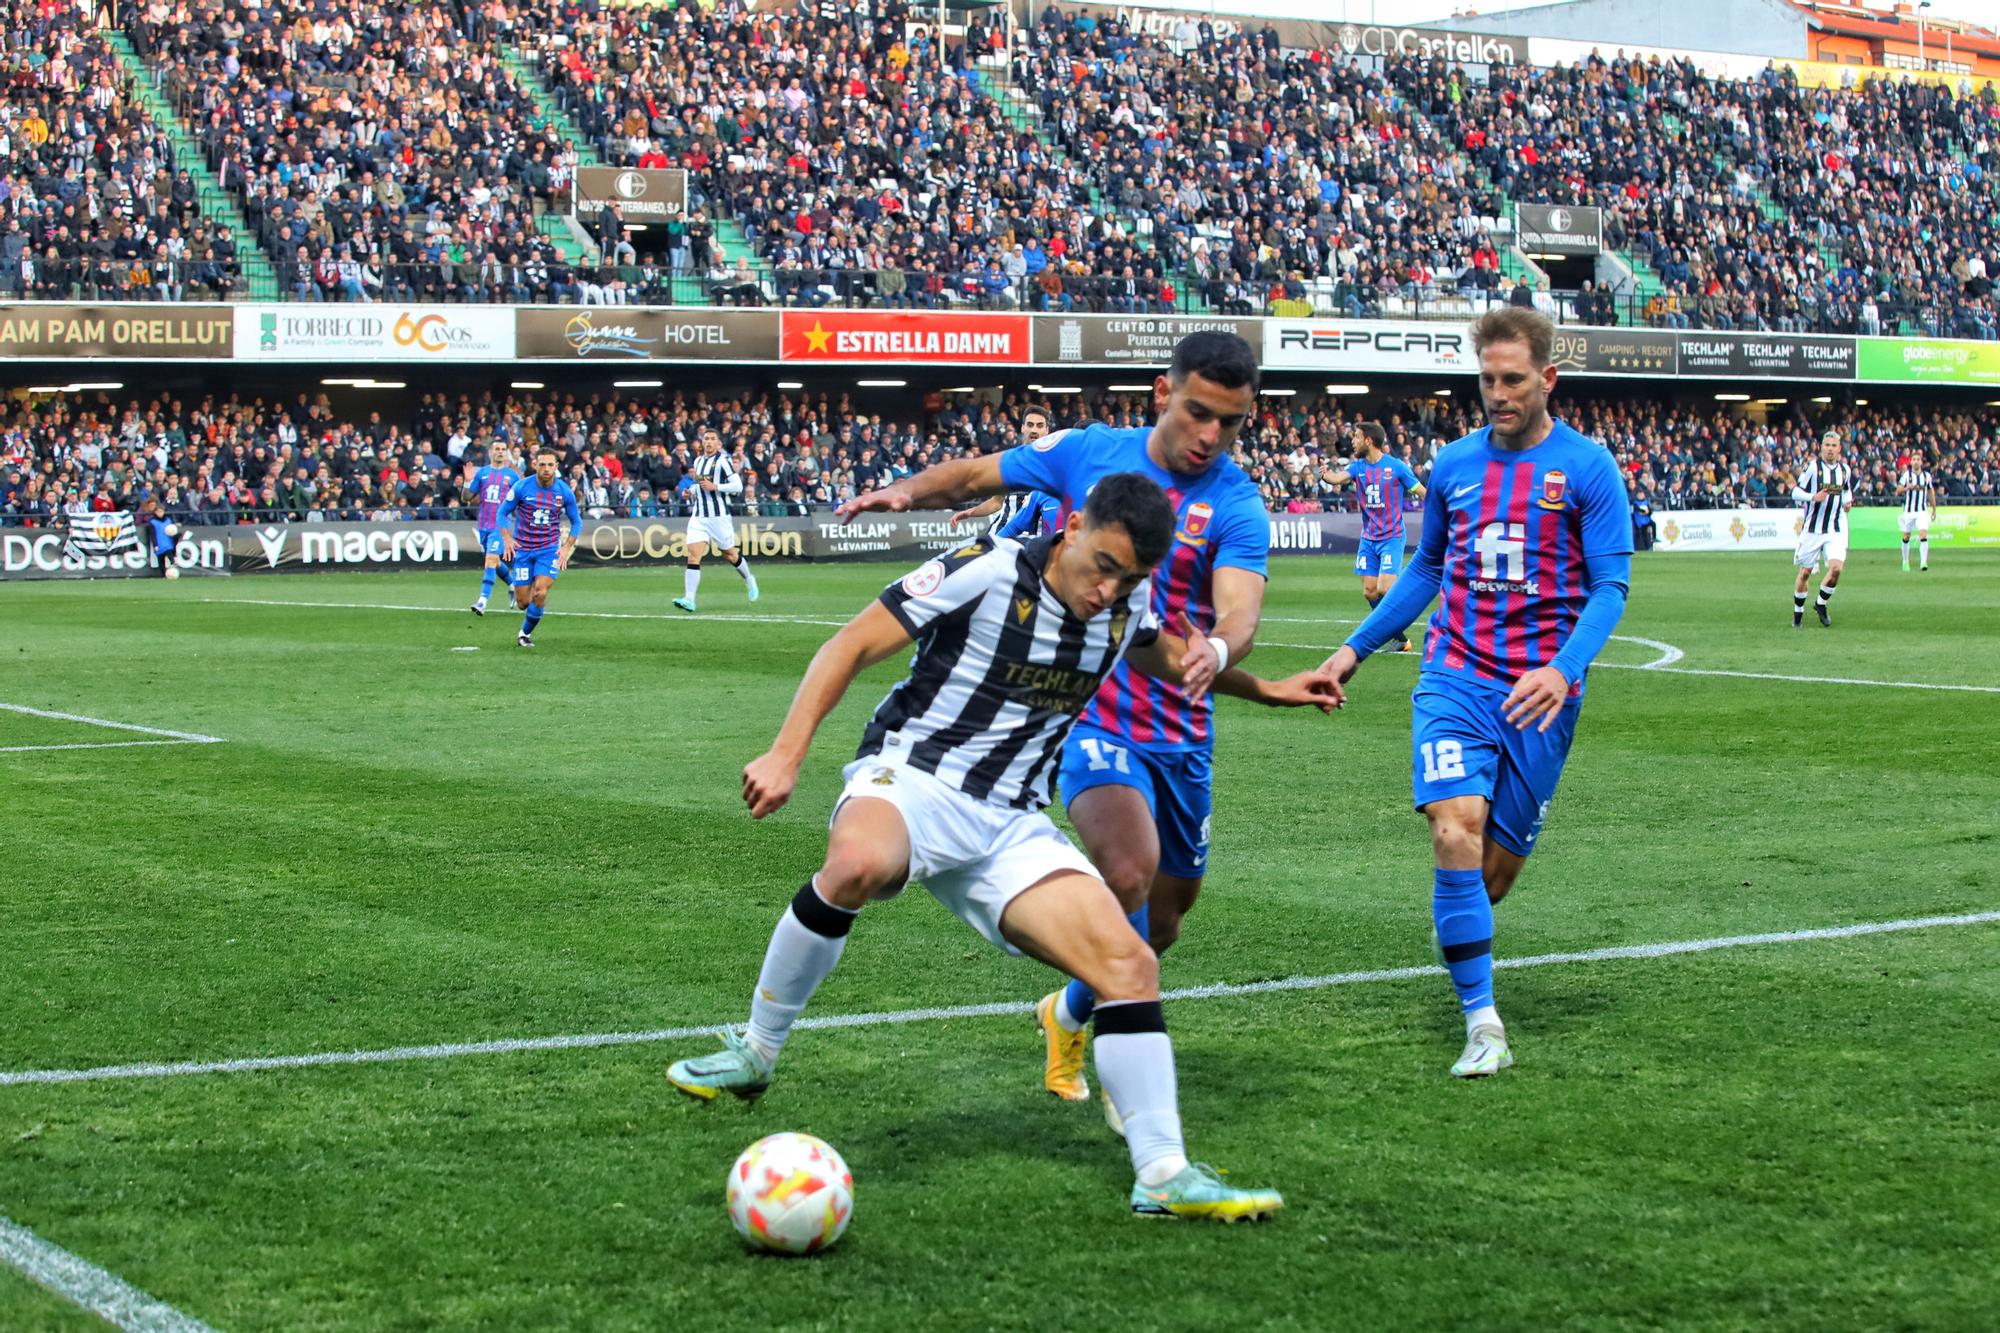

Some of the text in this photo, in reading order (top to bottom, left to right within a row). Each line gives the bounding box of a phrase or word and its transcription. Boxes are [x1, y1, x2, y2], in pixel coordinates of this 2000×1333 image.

[48, 320, 106, 343] PAM
[112, 320, 231, 344] ORELLUT
[283, 317, 383, 337] TORRECID
[665, 324, 731, 344] HOTEL
[1107, 321, 1238, 334] CENTRO DE NEGOCIOS
[836, 331, 1010, 354] ESTRELLA DAMM
[1127, 334, 1170, 346] PUERTA
[1281, 330, 1462, 353] REPCAR
[1599, 344, 1635, 354] CAMPING
[1641, 346, 1672, 356] RESORT
[1693, 358, 1729, 366] LEVANTINA
[1754, 359, 1790, 368] LEVANTINA
[1813, 361, 1848, 369] LEVANTINA
[302, 530, 459, 563] macron
[838, 542, 891, 551] LEVANTINA
[1469, 580, 1540, 595] network
[1080, 738, 1131, 775] 17
[1420, 740, 1467, 783] 12
